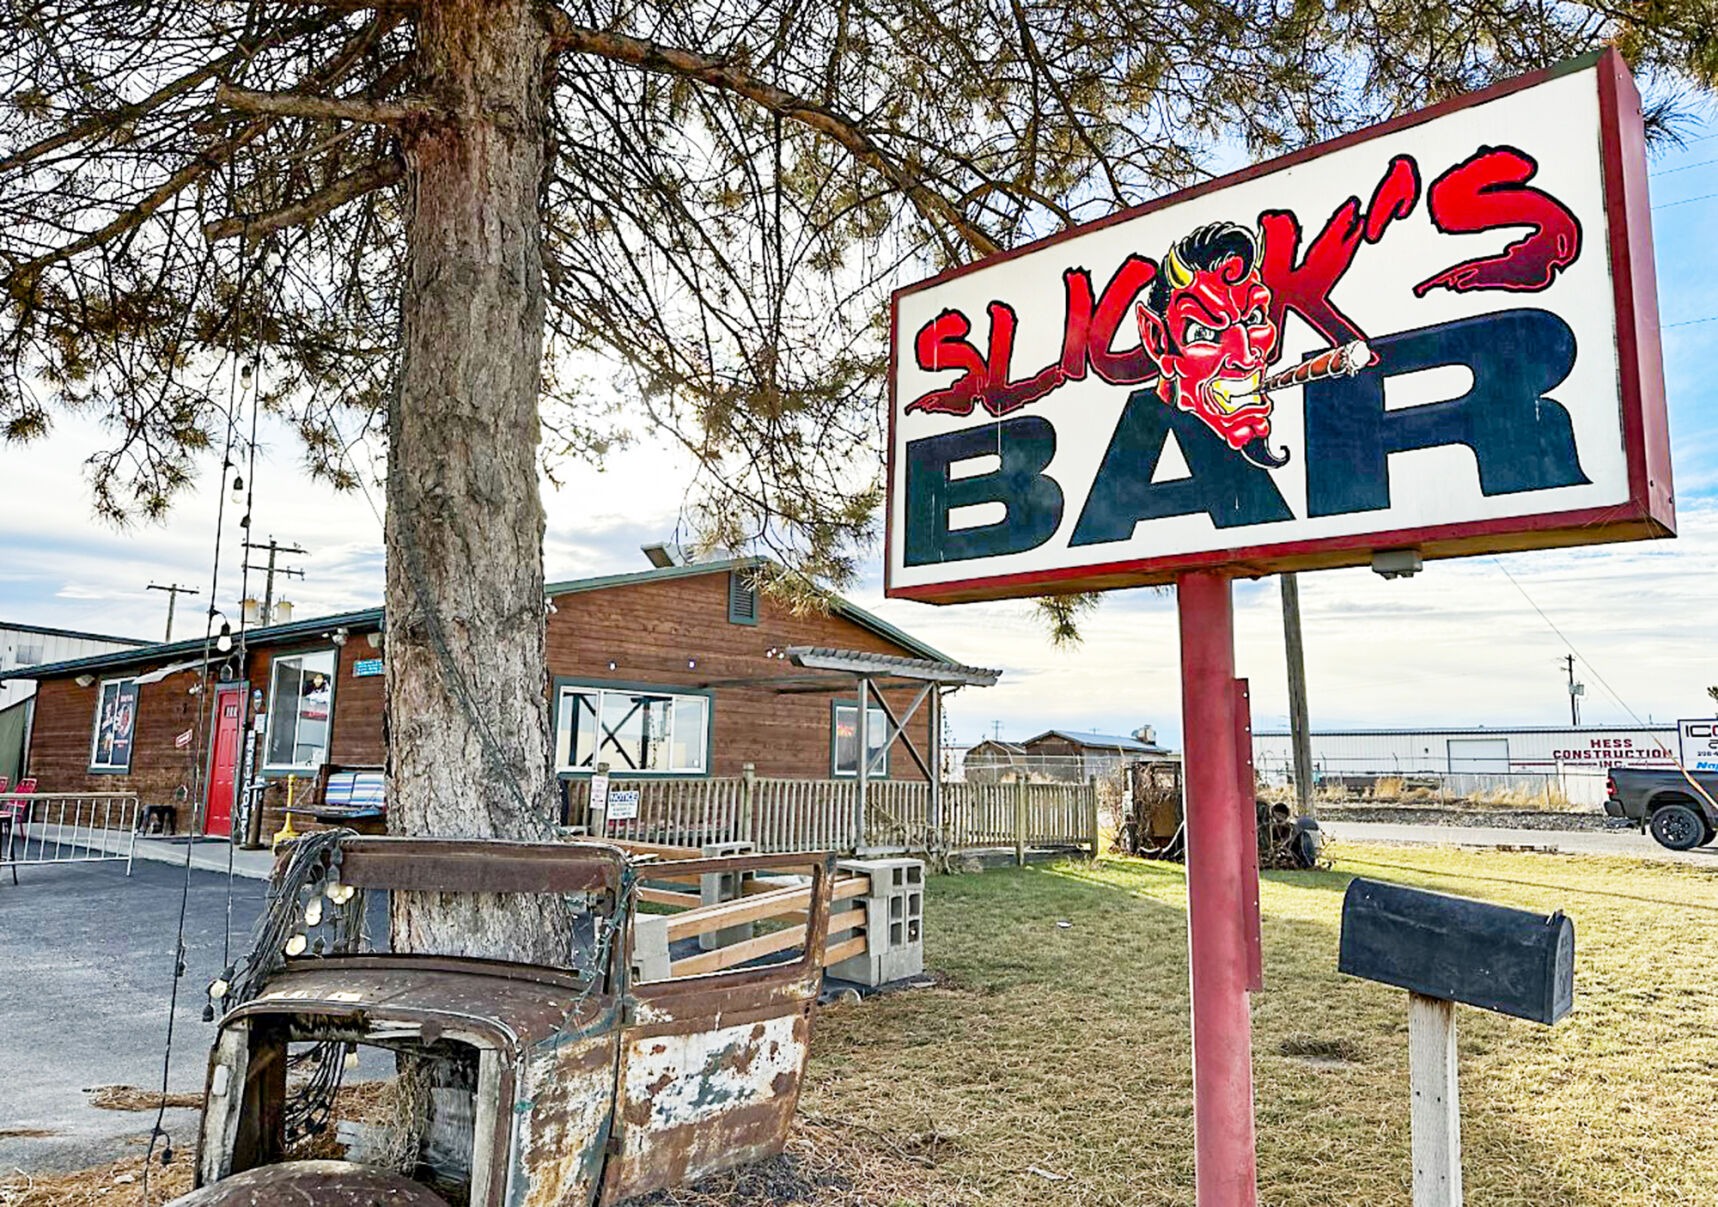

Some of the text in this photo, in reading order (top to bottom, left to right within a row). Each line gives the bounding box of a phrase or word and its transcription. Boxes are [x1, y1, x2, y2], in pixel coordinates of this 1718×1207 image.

[904, 144, 1583, 417] SLICK'S
[904, 307, 1592, 566] BAR
[1590, 738, 1632, 748] HESS
[1599, 760, 1626, 768] INC.
